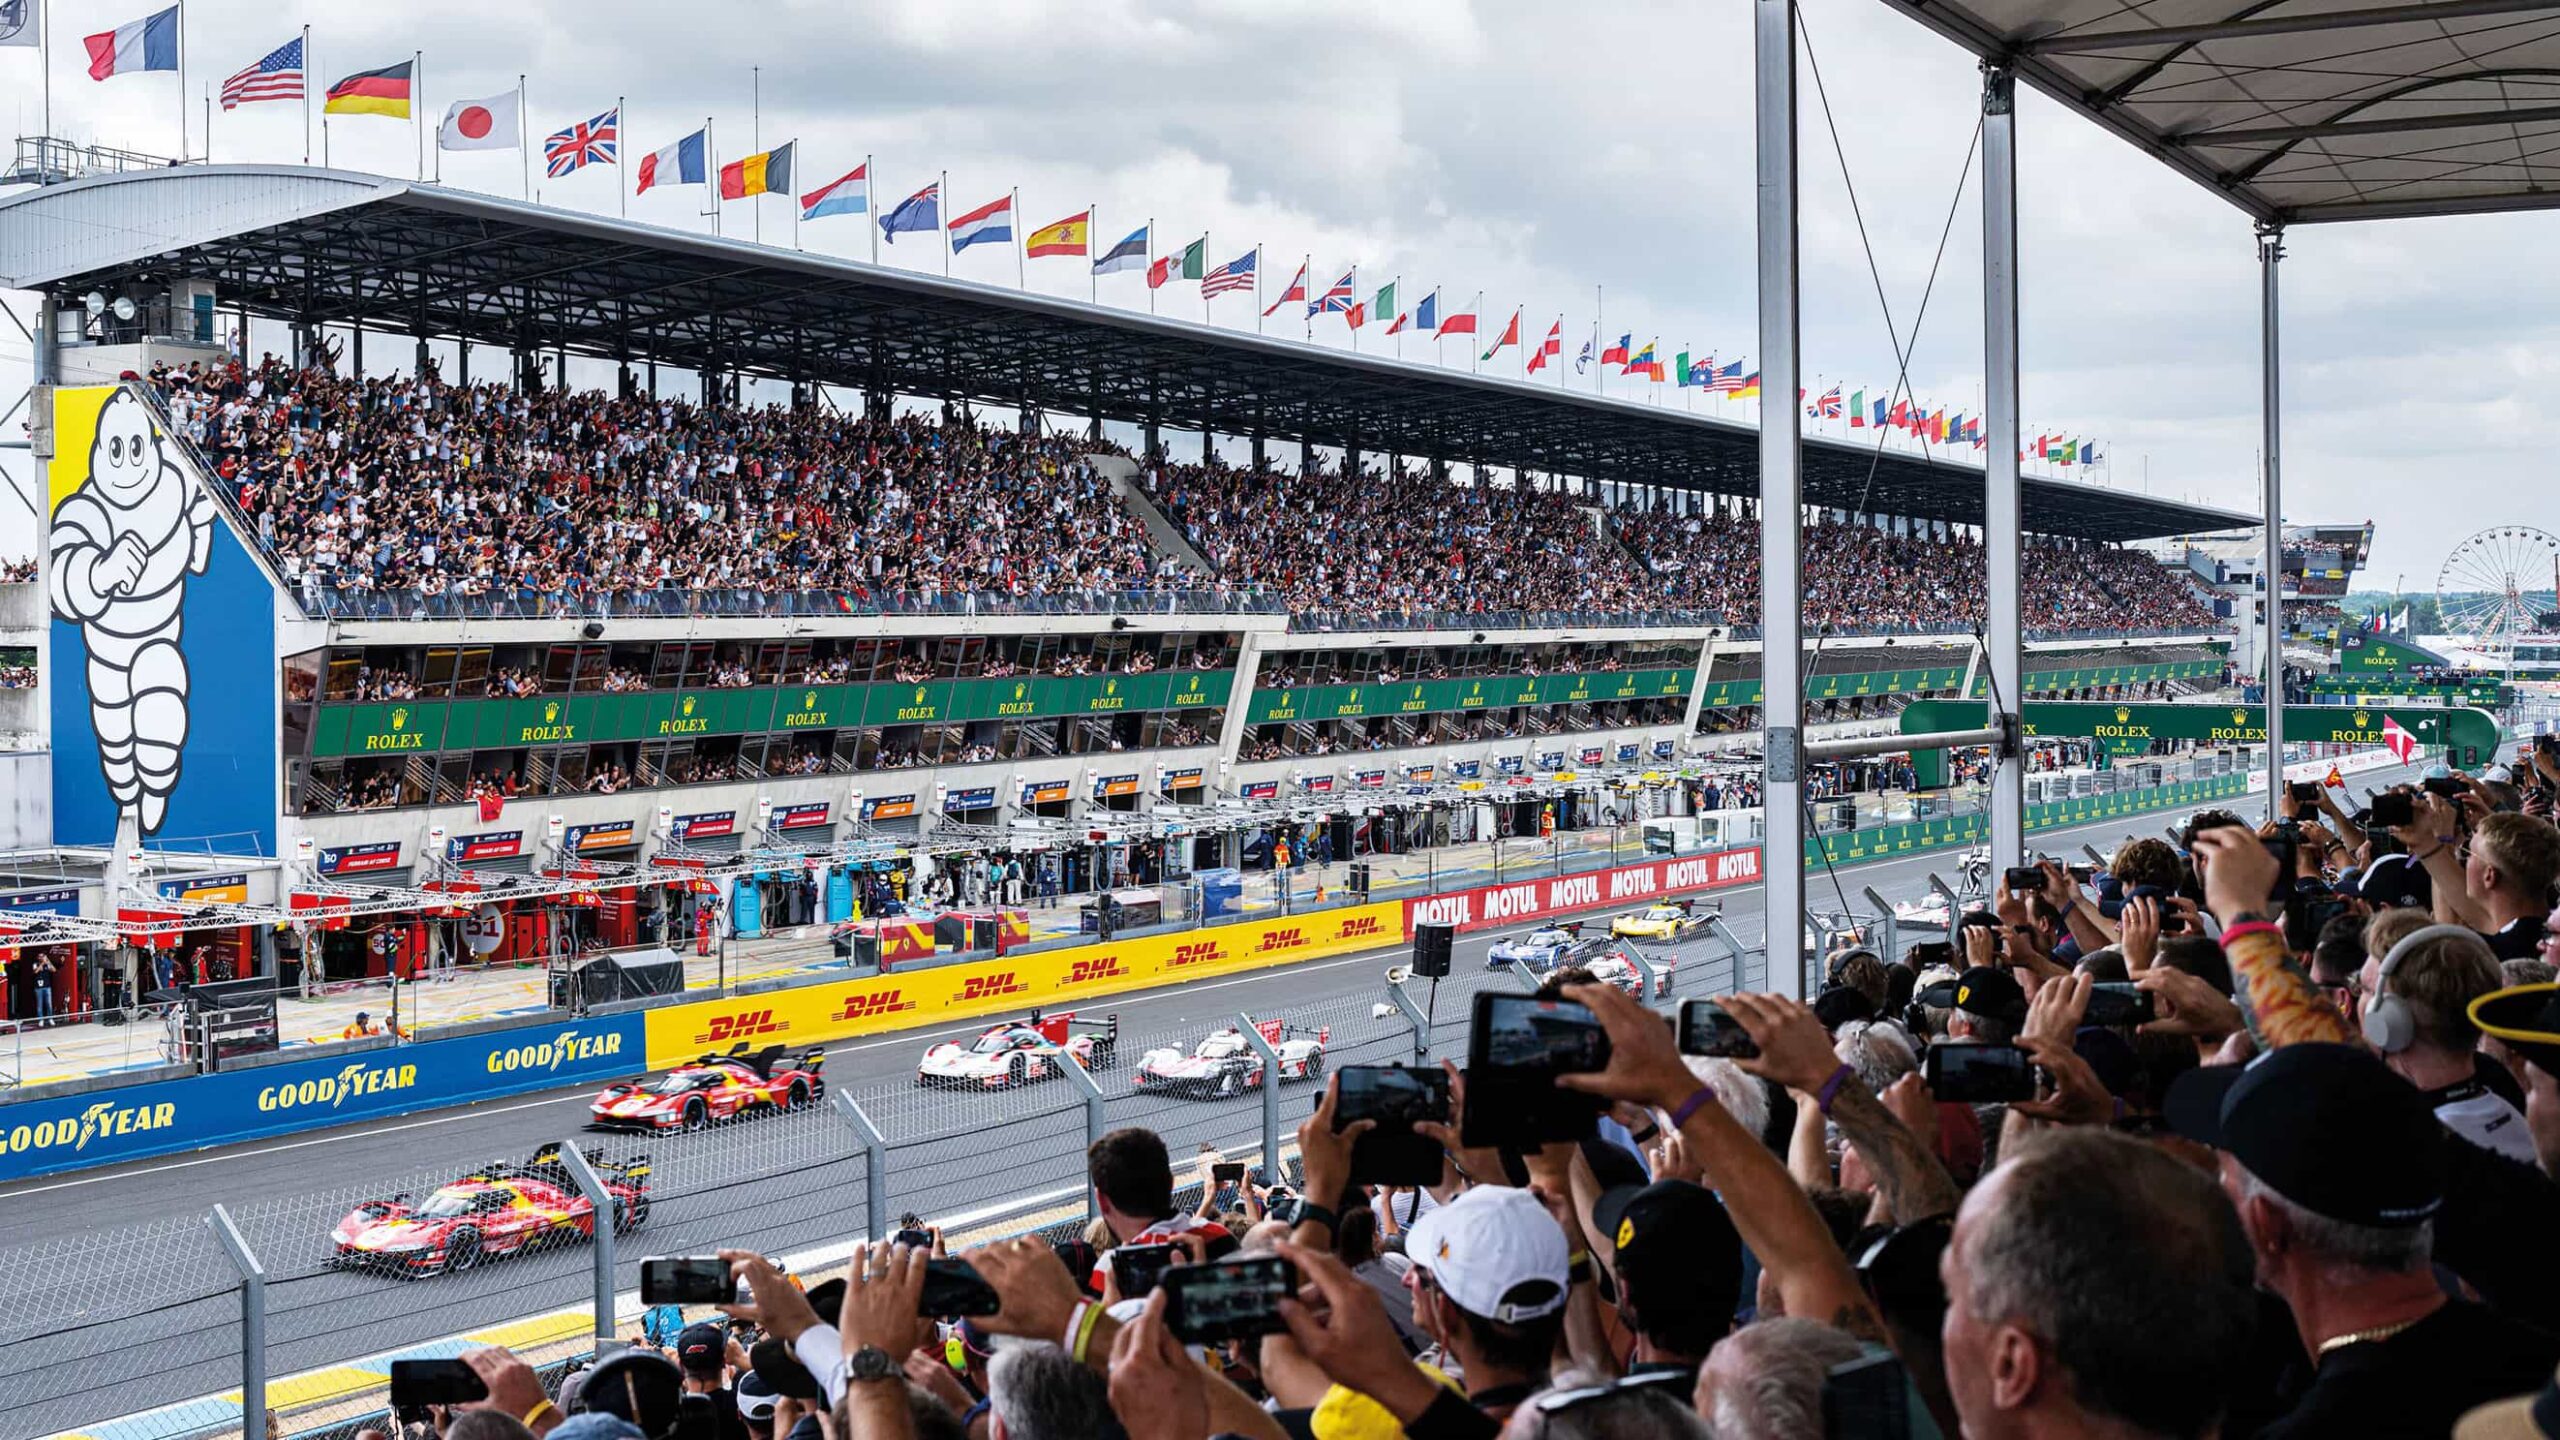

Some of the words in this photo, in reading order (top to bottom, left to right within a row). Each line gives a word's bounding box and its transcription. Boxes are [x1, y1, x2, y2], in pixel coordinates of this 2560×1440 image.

[1000, 701, 1034, 714] ROLEX
[1092, 697, 1123, 709] ROLEX
[1177, 693, 1204, 705] ROLEX
[1402, 700, 1426, 711] ROLEX
[786, 711, 827, 726] ROLEX
[898, 706, 935, 720] ROLEX
[1269, 708, 1294, 719] ROLEX
[1338, 705, 1363, 716] ROLEX
[521, 725, 574, 742] ROLEX
[660, 717, 708, 734] ROLEX
[2095, 725, 2150, 737] ROLEX
[2211, 728, 2267, 740] ROLEX
[366, 732, 423, 750] ROLEX
[1666, 858, 1709, 888] MOTUL
[1717, 850, 1757, 880] MOTUL
[1550, 876, 1599, 908] MOTUL
[1611, 867, 1656, 898] MOTUL
[1413, 895, 1470, 926] MOTUL
[1484, 885, 1538, 919] MOTUL
[1342, 916, 1379, 938] DHL
[1263, 928, 1304, 951] DHL
[1176, 942, 1219, 965] DHL
[1072, 957, 1119, 982] DHL
[964, 972, 1020, 999] DHL
[843, 990, 908, 1019] DHL
[706, 1010, 780, 1041] DHL
[488, 1032, 621, 1072] GOODYEAR
[258, 1064, 417, 1112] GOODYEAR
